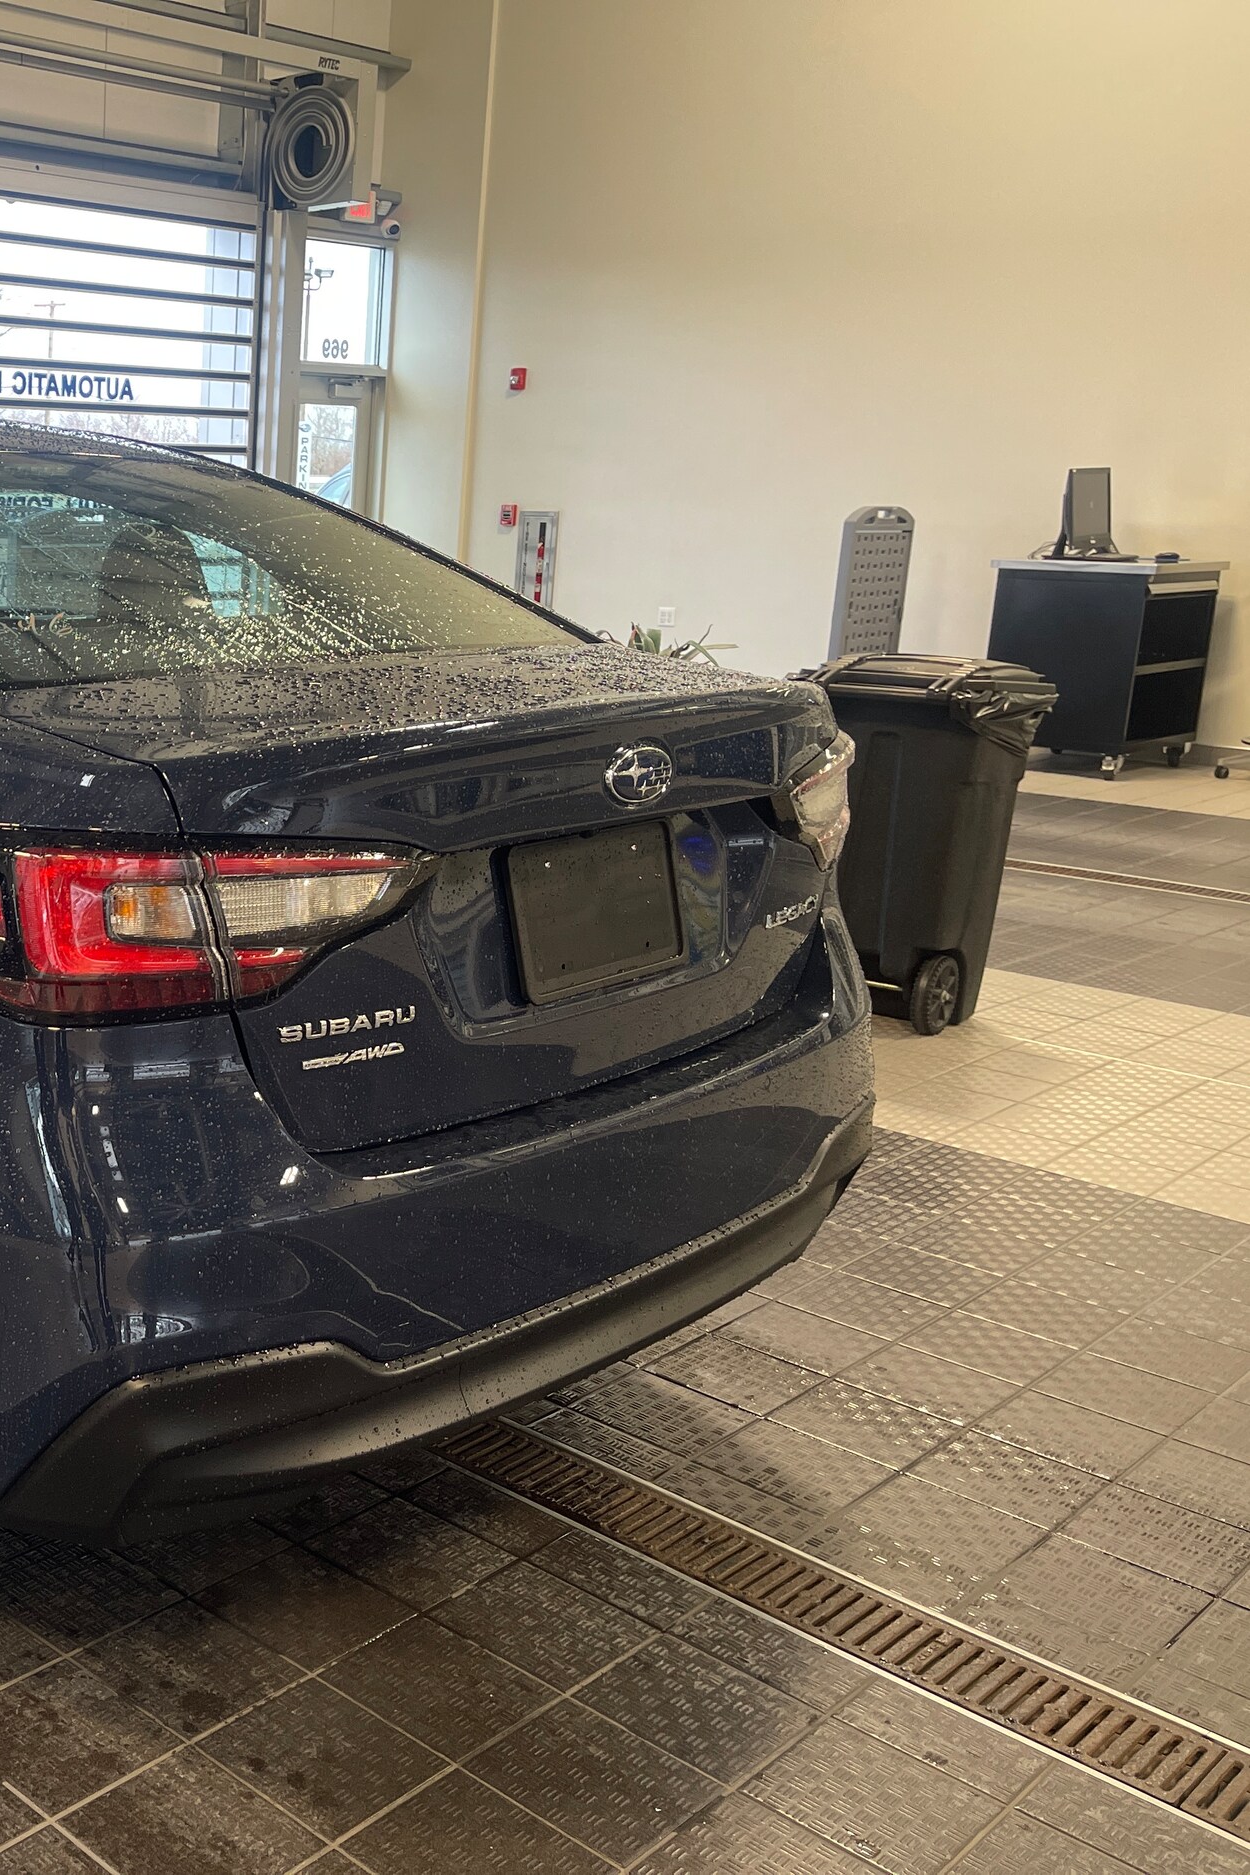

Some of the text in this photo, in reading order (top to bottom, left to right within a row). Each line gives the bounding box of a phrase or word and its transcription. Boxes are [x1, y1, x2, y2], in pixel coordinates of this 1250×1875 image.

[298, 437, 309, 490] PARKIN
[766, 894, 819, 929] LEGACY
[277, 1005, 416, 1043] SUBARU
[343, 1042, 405, 1064] AWD
